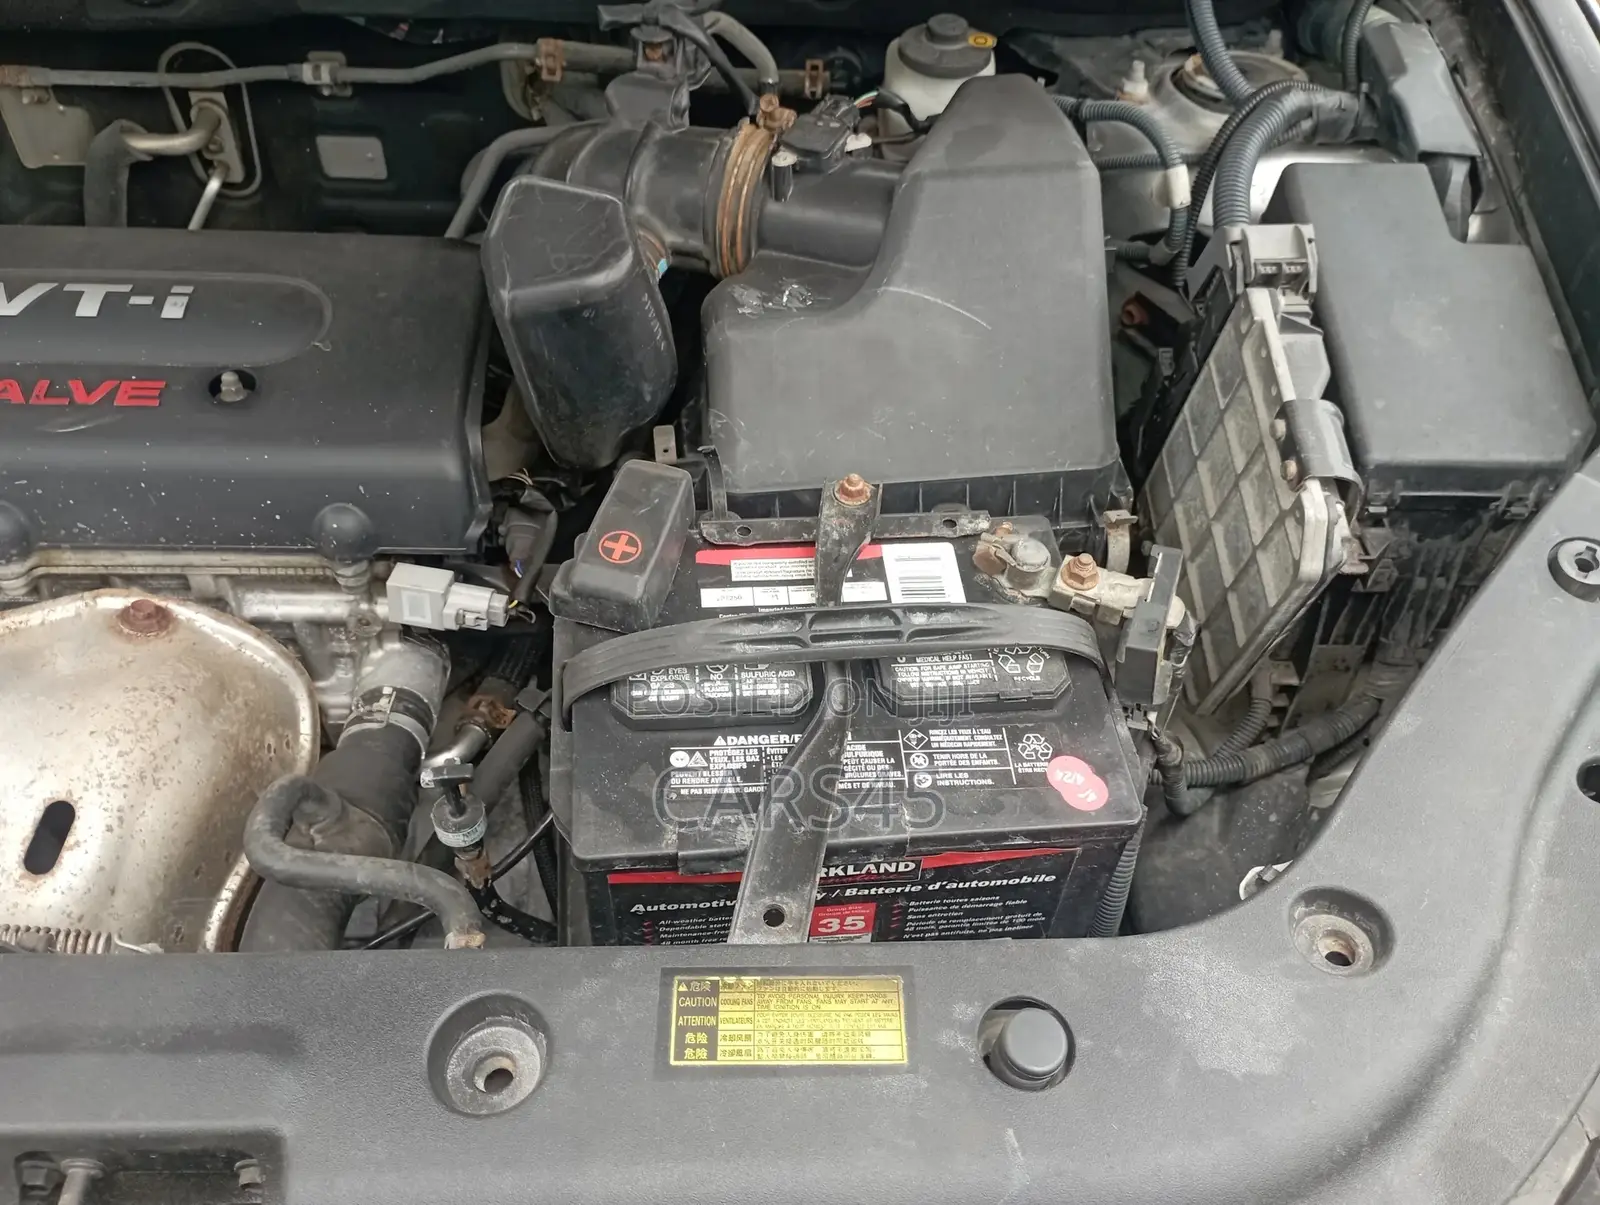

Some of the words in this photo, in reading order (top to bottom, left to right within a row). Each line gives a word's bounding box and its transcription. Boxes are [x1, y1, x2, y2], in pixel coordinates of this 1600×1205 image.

[668, 667, 688, 675] EYES
[710, 673, 723, 681] NO
[820, 861, 917, 878] RKLAND
[630, 899, 737, 914] Automotiv
[844, 884, 922, 897] Batterie
[927, 873, 1056, 891] d'automobile
[659, 917, 706, 926] All-weather
[817, 915, 866, 933] 35
[659, 924, 707, 932] Dependable
[678, 996, 717, 1007] CAUTION
[678, 1016, 716, 1026] ATTENTION
